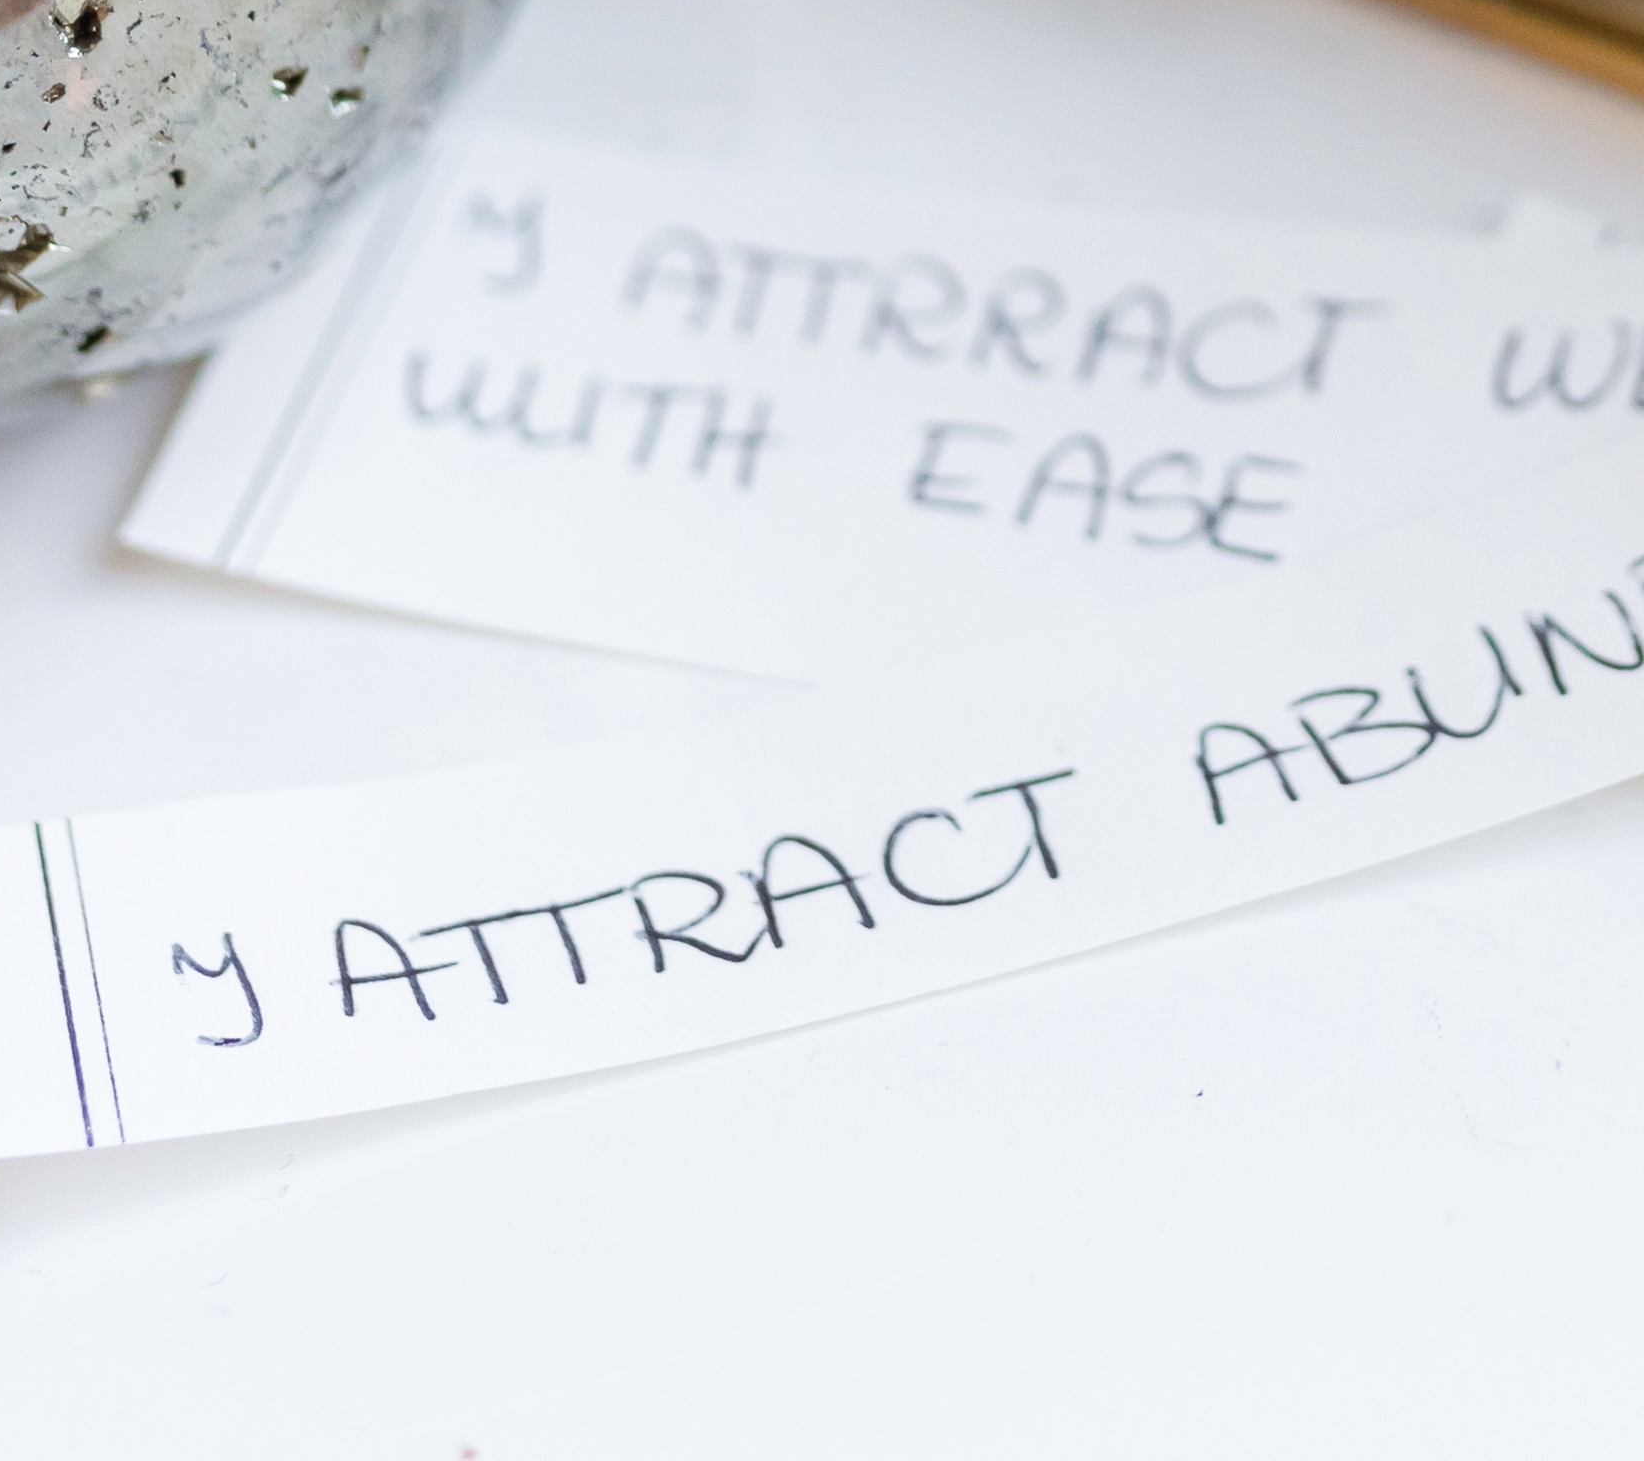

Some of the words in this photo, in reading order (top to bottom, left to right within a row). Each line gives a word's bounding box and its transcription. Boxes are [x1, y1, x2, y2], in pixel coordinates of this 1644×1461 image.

[402, 346, 781, 492] WITH
[906, 419, 1306, 565] EASE
[328, 767, 1076, 1021] ATTRACT
